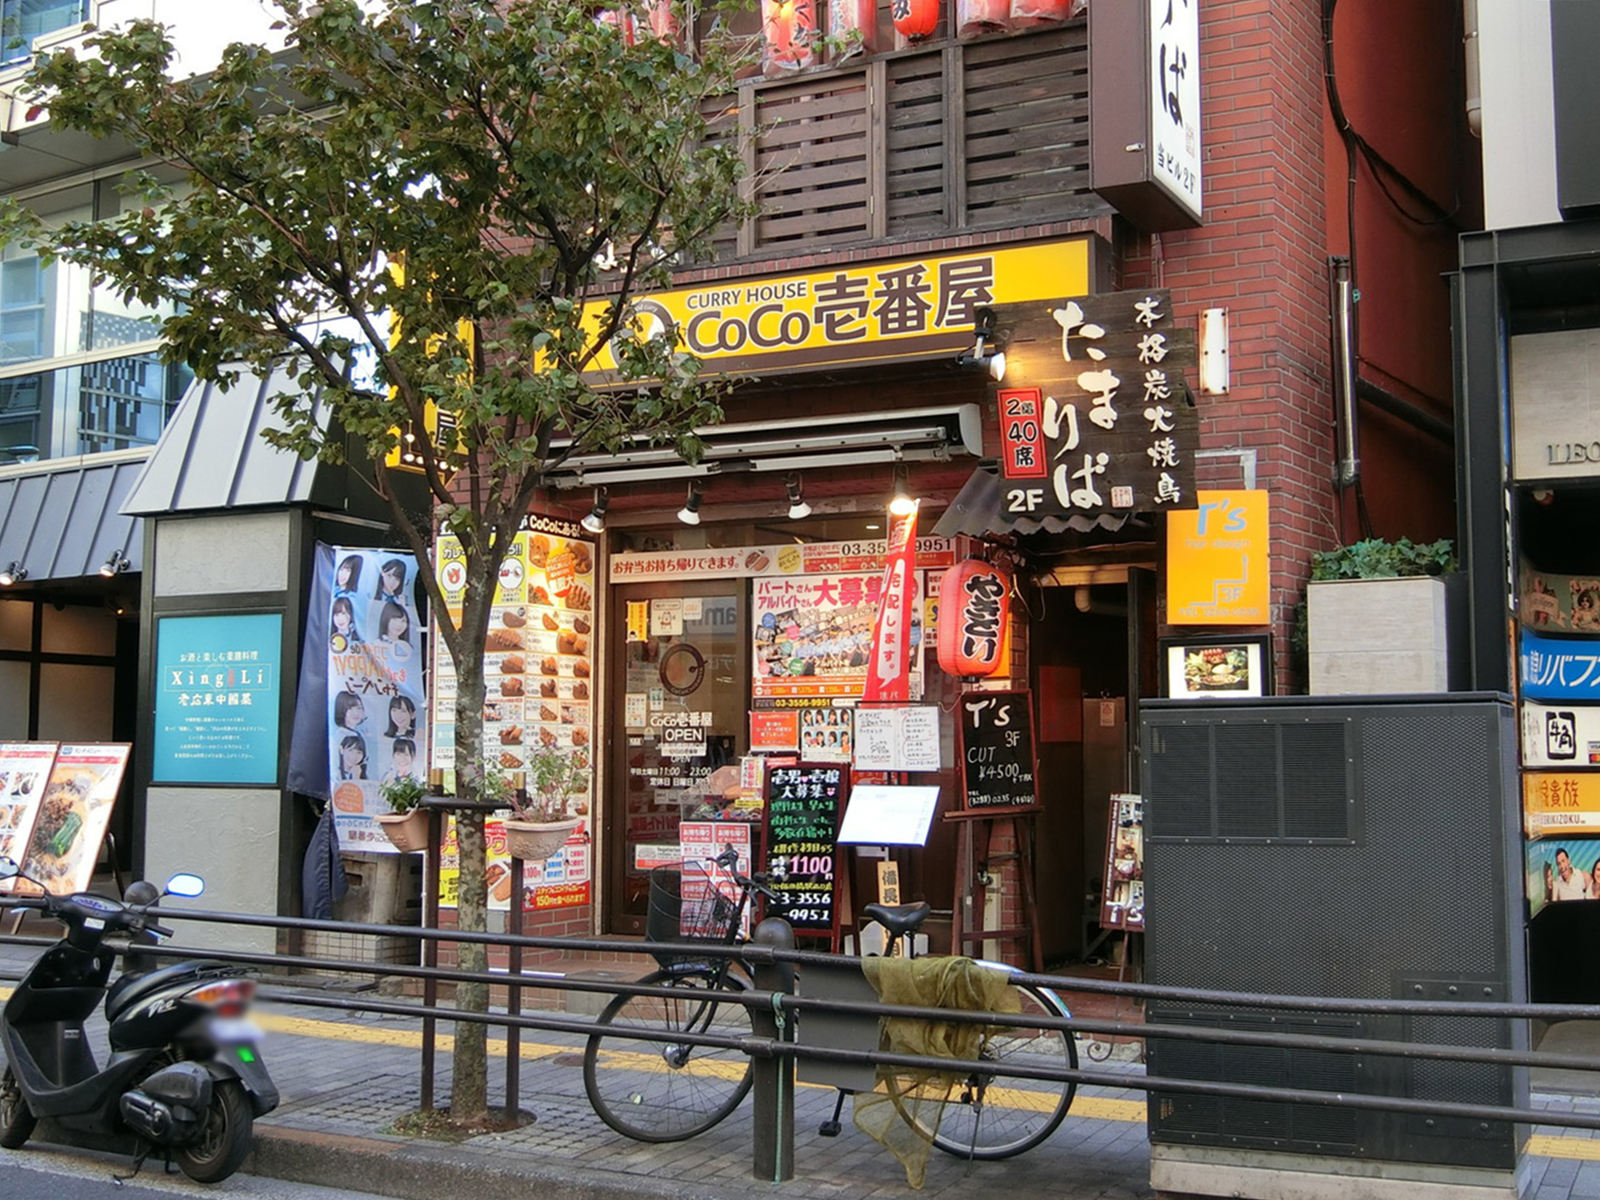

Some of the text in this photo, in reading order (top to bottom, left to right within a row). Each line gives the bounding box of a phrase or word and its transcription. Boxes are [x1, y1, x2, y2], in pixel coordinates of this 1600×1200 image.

[687, 280, 807, 310] CURRY HOUSE
[686, 256, 995, 355] CoCo壱番屋
[1042, 301, 1121, 509] たまりば
[1134, 297, 1181, 504] 本格炭火焼鳥
[1007, 488, 1044, 513] 2F
[1197, 498, 1248, 536] T's
[1212, 537, 1252, 551] design
[613, 555, 740, 575] お弁当お持ち帰りできます。
[1220, 586, 1245, 603] 3F
[963, 572, 1004, 663] やきとり
[171, 668, 265, 688] Xing Li
[650, 712, 713, 728] CoCo壱番屋
[964, 698, 1011, 729] T's
[664, 728, 703, 743] OPEN
[1004, 730, 1021, 748] 3F
[1549, 719, 1573, 749] 牛角
[967, 746, 997, 764] CUT
[978, 762, 1020, 782] ¥4500
[781, 784, 825, 798] 大募集
[790, 854, 832, 875] 1100
[148, 999, 177, 1018] Dio
